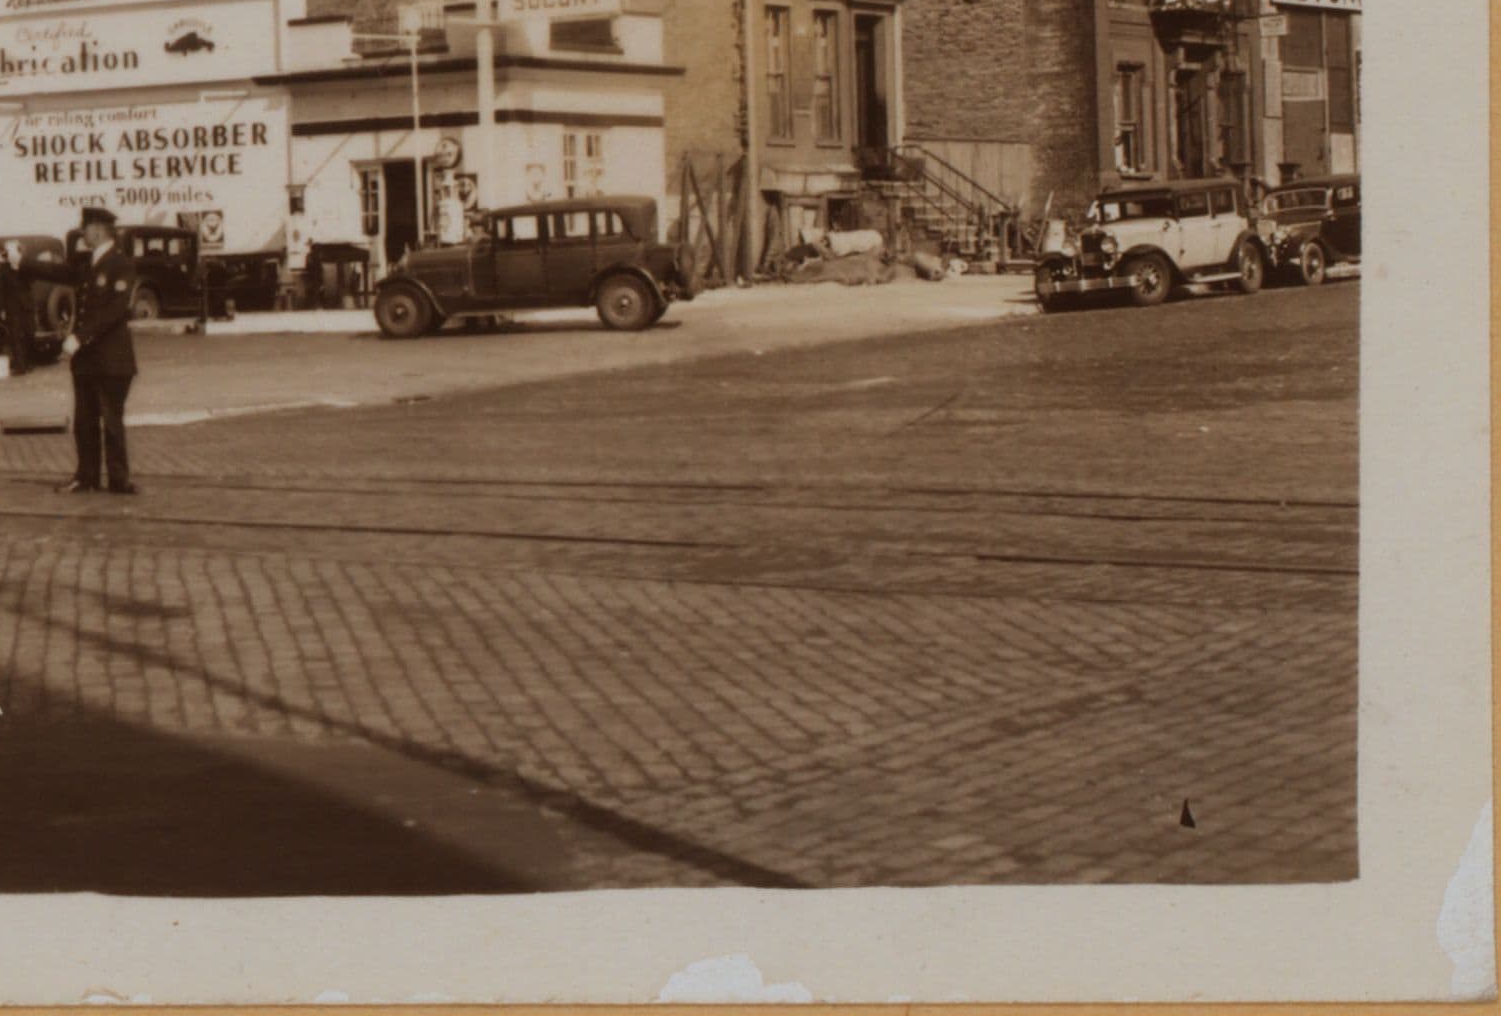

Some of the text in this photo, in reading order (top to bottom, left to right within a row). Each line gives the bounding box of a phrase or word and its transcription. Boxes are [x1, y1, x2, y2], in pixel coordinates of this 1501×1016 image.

[14, 122, 269, 158] SHOCK ABSORBER
[35, 152, 243, 184] REFILL SERVICE
[59, 186, 214, 208] every 5000 miles
